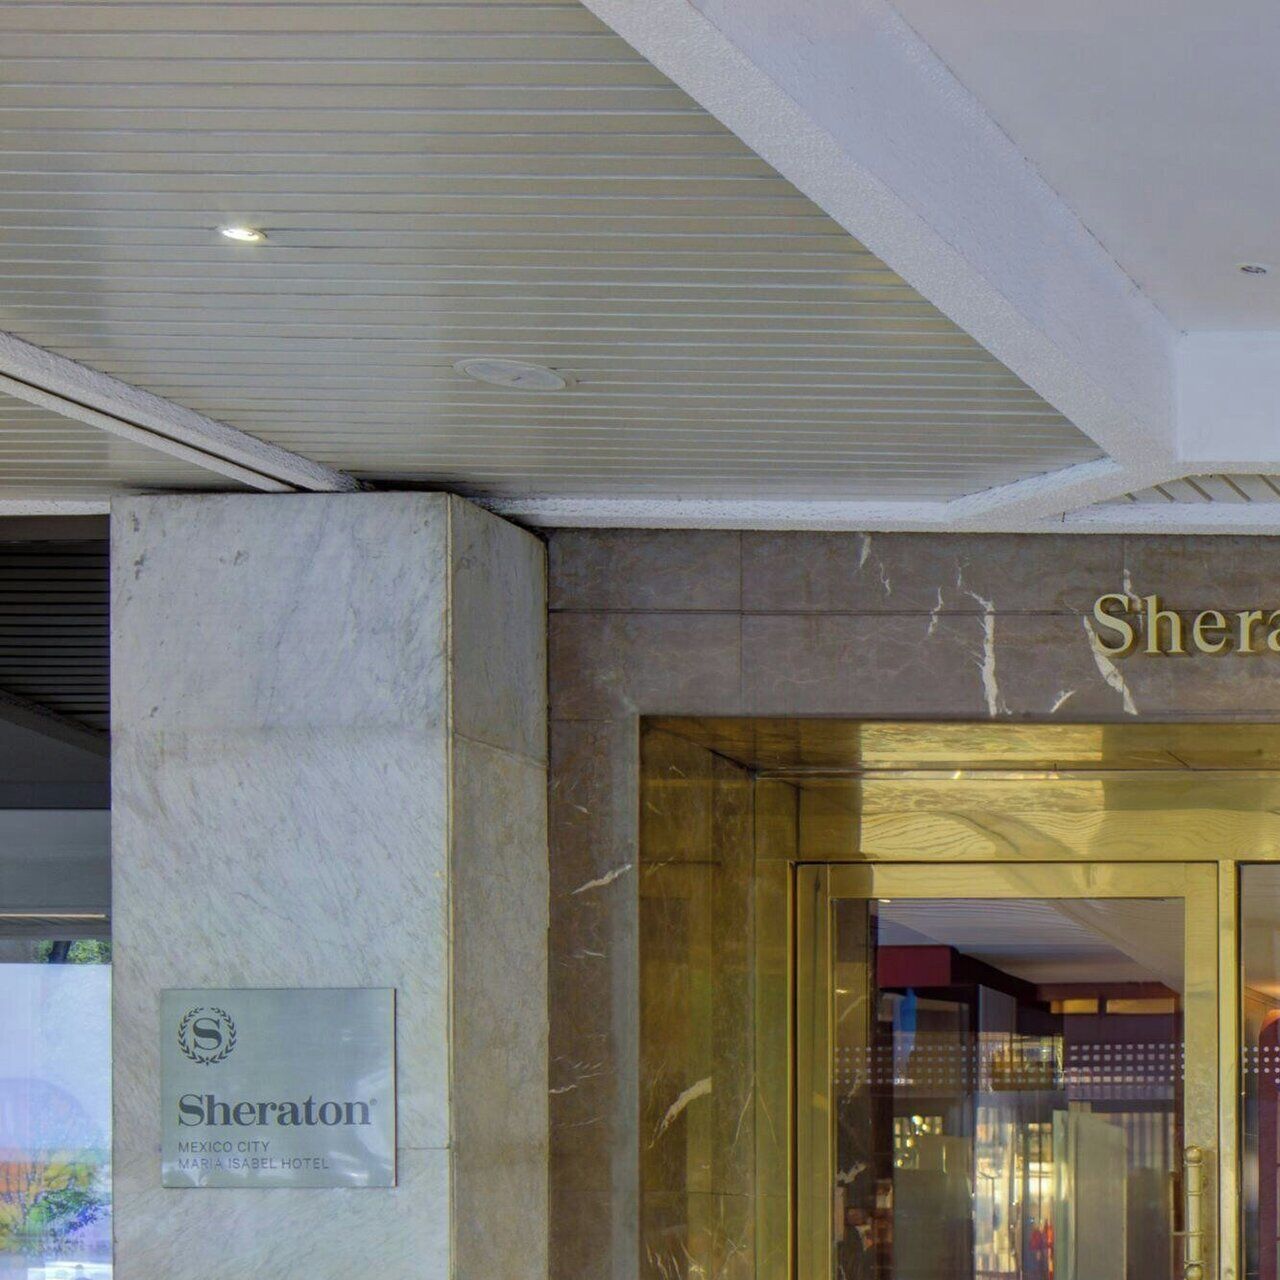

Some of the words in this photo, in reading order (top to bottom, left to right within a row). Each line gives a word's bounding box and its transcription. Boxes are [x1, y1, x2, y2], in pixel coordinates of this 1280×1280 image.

[192, 1017, 223, 1051] S
[178, 1093, 372, 1127] Sheraton
[178, 1140, 233, 1153] MEXICO
[237, 1140, 271, 1153] CITY
[178, 1157, 222, 1170] MARIA
[228, 1157, 277, 1170] ISABEL
[281, 1157, 329, 1170] HOTEL
